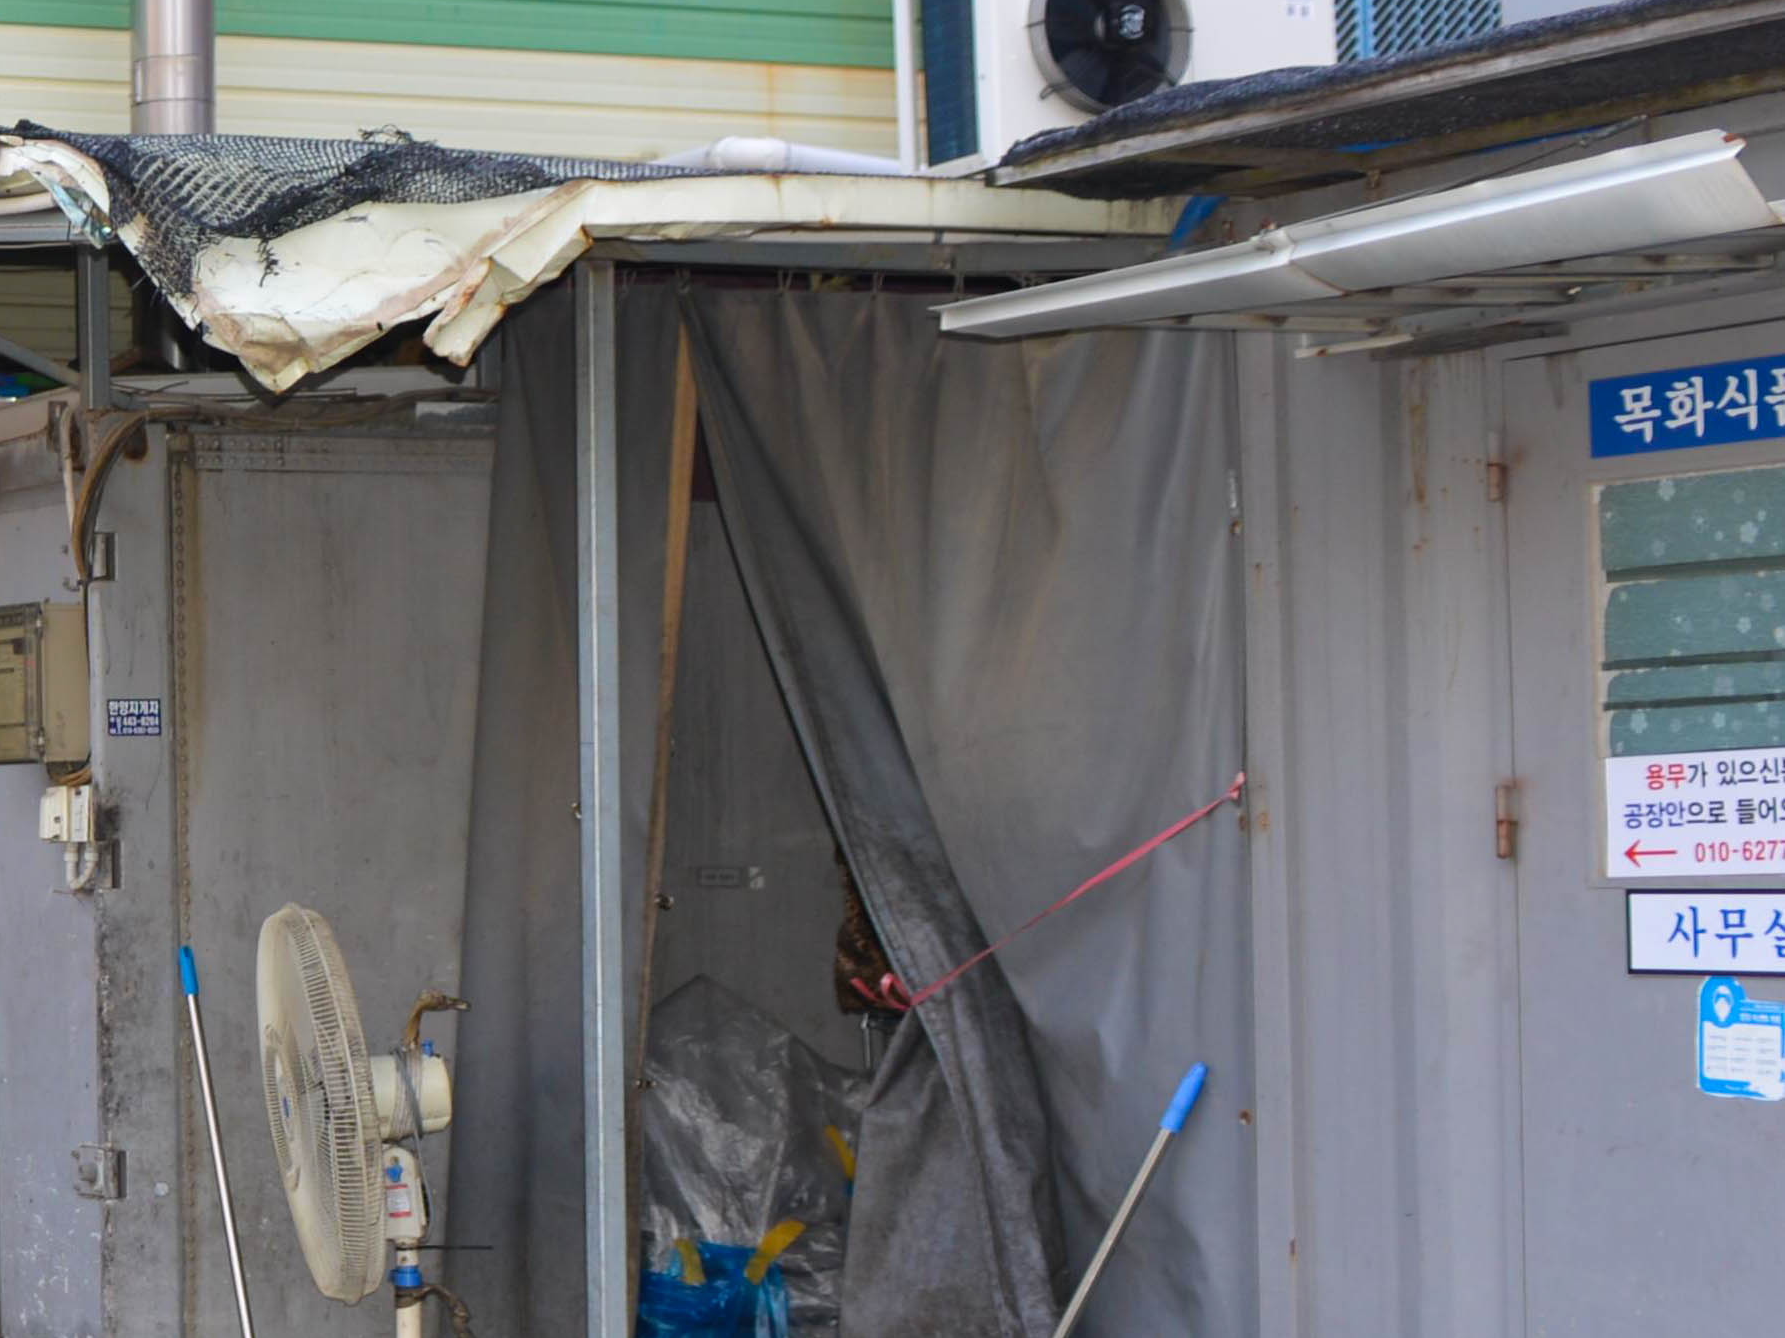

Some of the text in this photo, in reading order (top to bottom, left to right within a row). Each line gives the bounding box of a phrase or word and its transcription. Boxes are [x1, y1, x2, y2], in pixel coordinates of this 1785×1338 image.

[1645, 757, 1785, 791] 용무가 있으신
[1623, 797, 1785, 830] 공장안으로 들어
